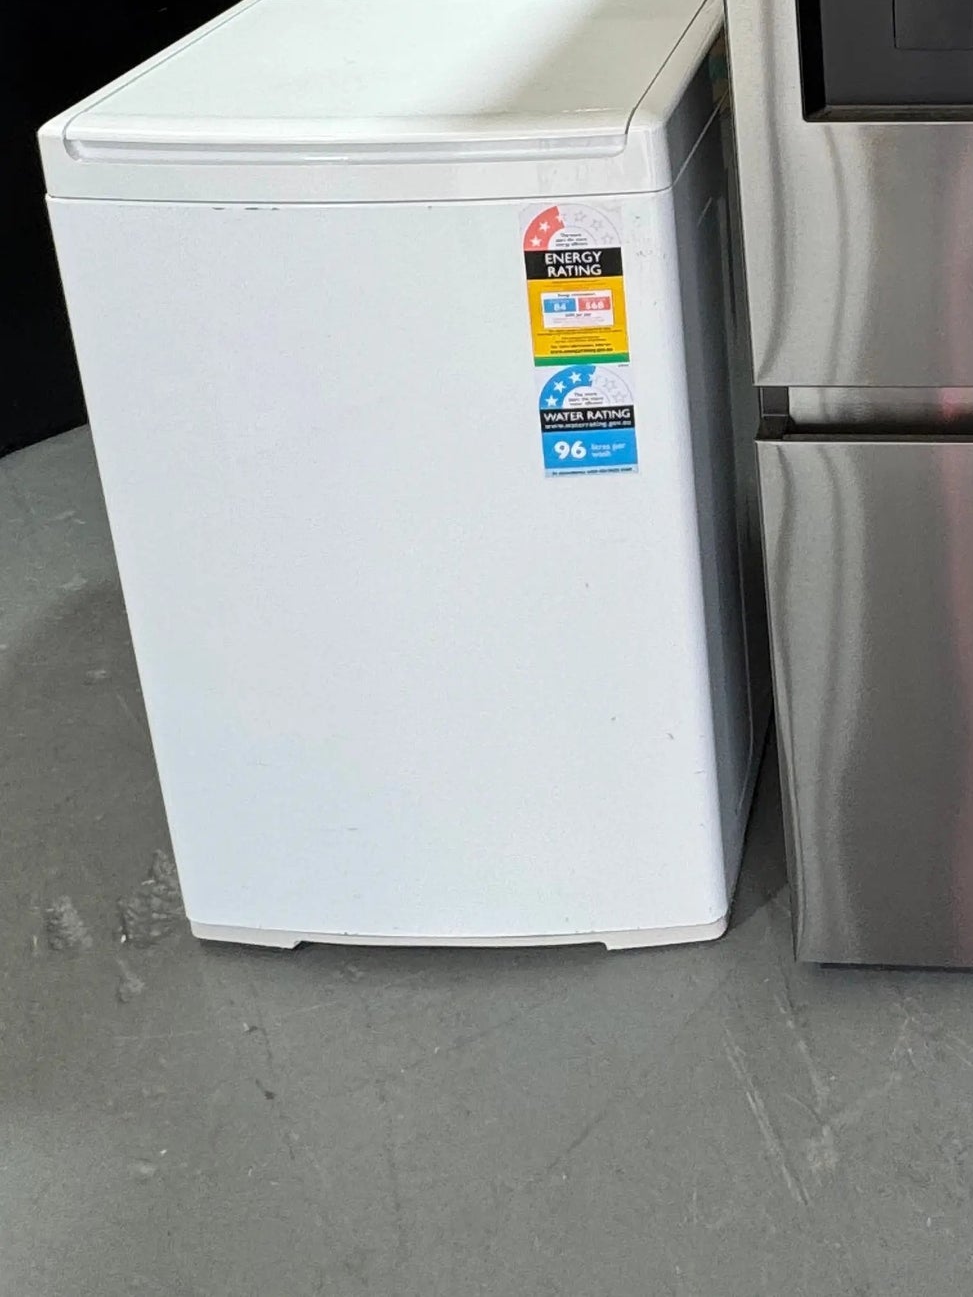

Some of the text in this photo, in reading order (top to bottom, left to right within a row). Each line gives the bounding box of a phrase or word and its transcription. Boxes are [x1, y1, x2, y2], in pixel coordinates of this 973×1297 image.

[545, 251, 602, 265] ENERGY
[547, 264, 602, 278] RATING
[543, 408, 631, 422] WATER RATING
[554, 440, 587, 460] 96
